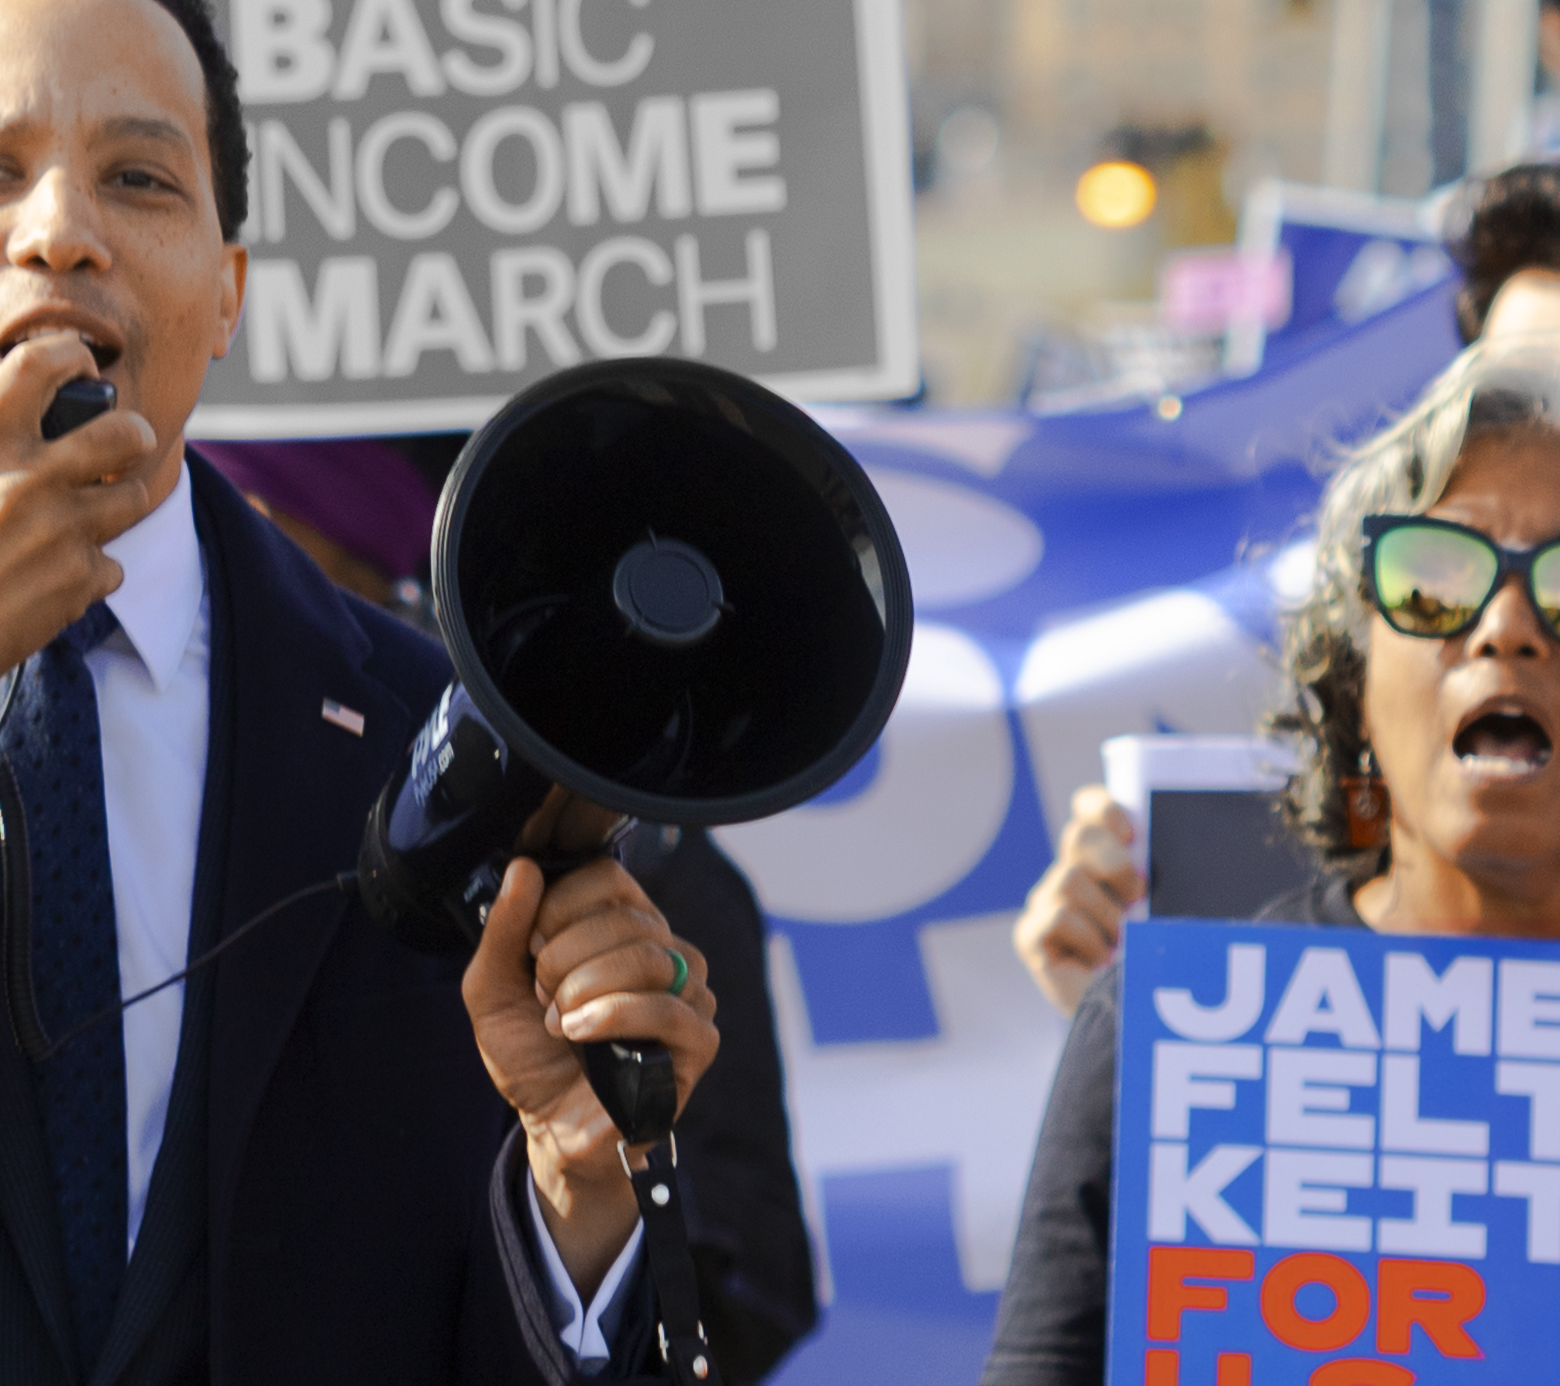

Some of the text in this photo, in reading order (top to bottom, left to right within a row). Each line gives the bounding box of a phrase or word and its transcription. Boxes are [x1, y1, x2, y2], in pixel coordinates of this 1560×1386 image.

[245, 86, 787, 244] INCOME
[247, 227, 777, 383] MARCH
[1145, 1245, 1488, 1361] FOR
